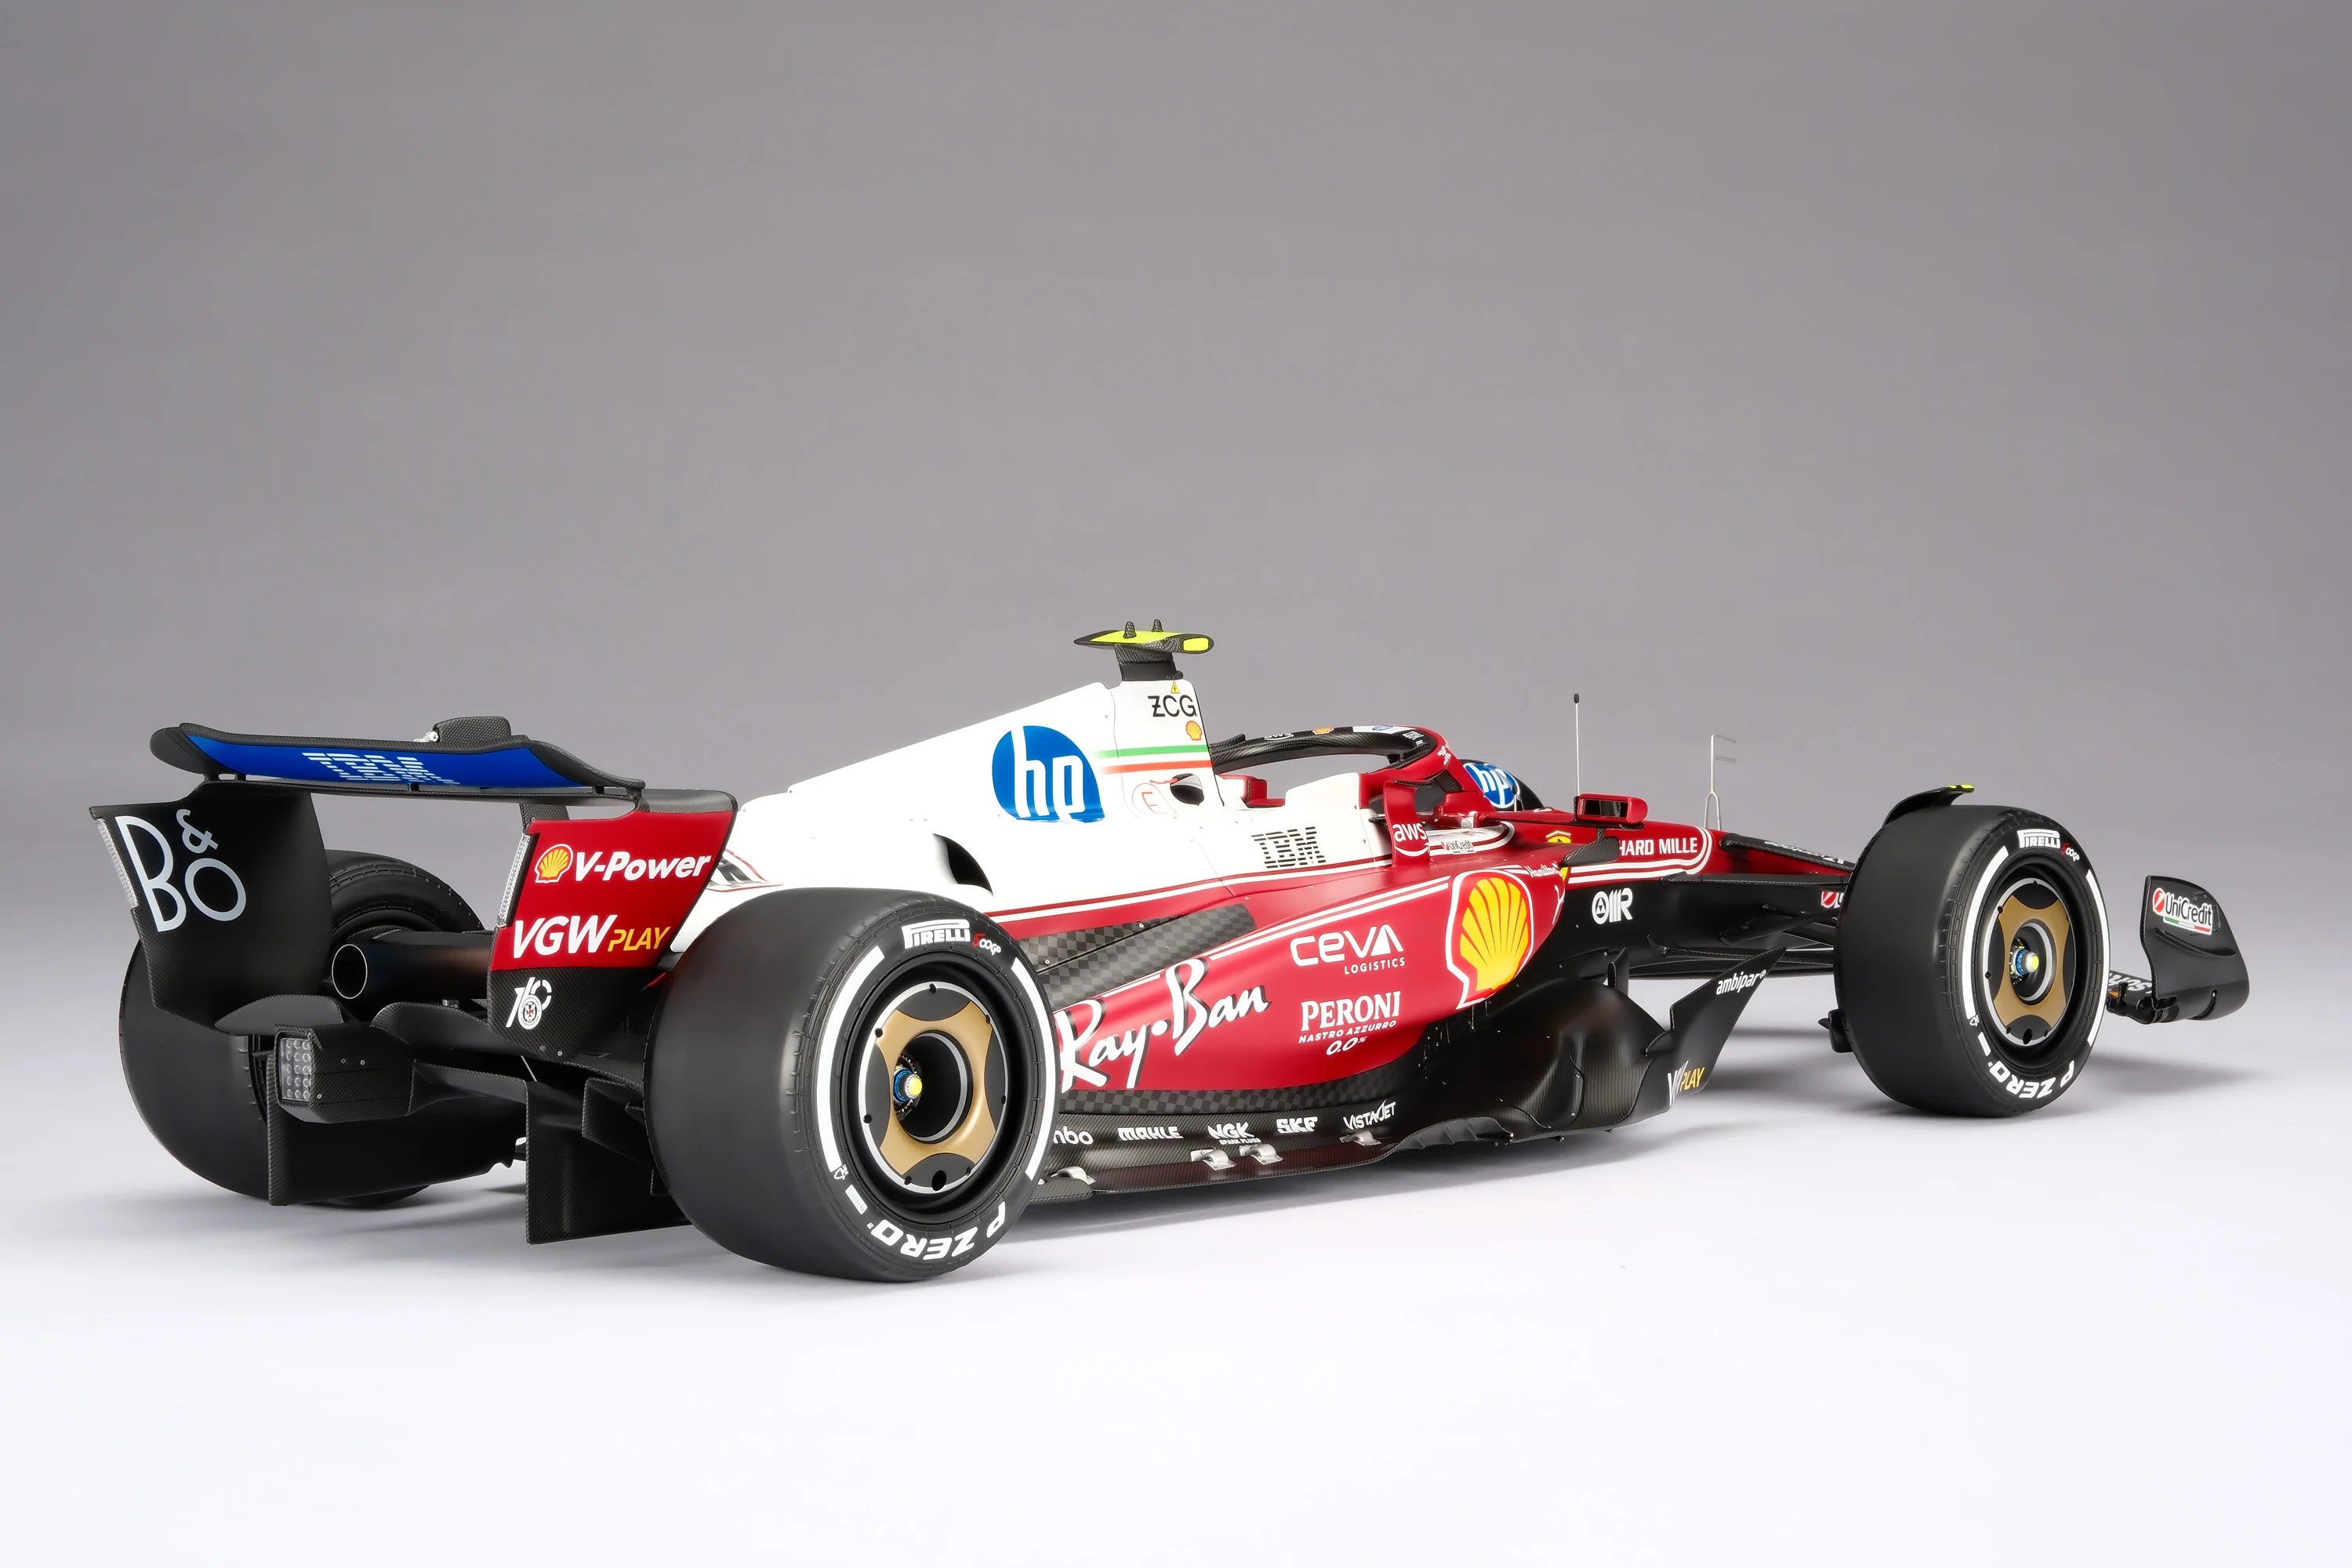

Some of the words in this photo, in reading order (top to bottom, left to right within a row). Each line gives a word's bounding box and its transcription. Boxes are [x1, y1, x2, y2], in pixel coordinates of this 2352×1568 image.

[1011, 724, 1087, 823] hp
[1470, 763, 1510, 807] hp
[1392, 822, 1428, 843] aws
[2016, 829, 2060, 849] PIRELLI
[1251, 826, 1327, 869] IBM
[1619, 839, 1654, 856] HARD
[1659, 837, 1698, 855] MILLE
[575, 851, 712, 881] V-Power
[2165, 894, 2212, 926] UniCredit
[514, 914, 618, 959] VGW
[608, 927, 671, 953] PLAY
[902, 919, 971, 949] PIRELLI
[1344, 956, 1405, 975] LOGISTICS
[1301, 990, 1401, 1032] PERONI
[1298, 1029, 1344, 1044] NASTRO
[1345, 1020, 1397, 1036] AZZURRO
[1679, 1067, 1706, 1092] PLAY
[2060, 1060, 2075, 1087] P
[1053, 1126, 1094, 1145] mbo
[1118, 1126, 1184, 1142] MAHLE
[1207, 1121, 1254, 1139] NGK
[1276, 1116, 1319, 1134] SKF
[985, 1200, 1006, 1238] P
